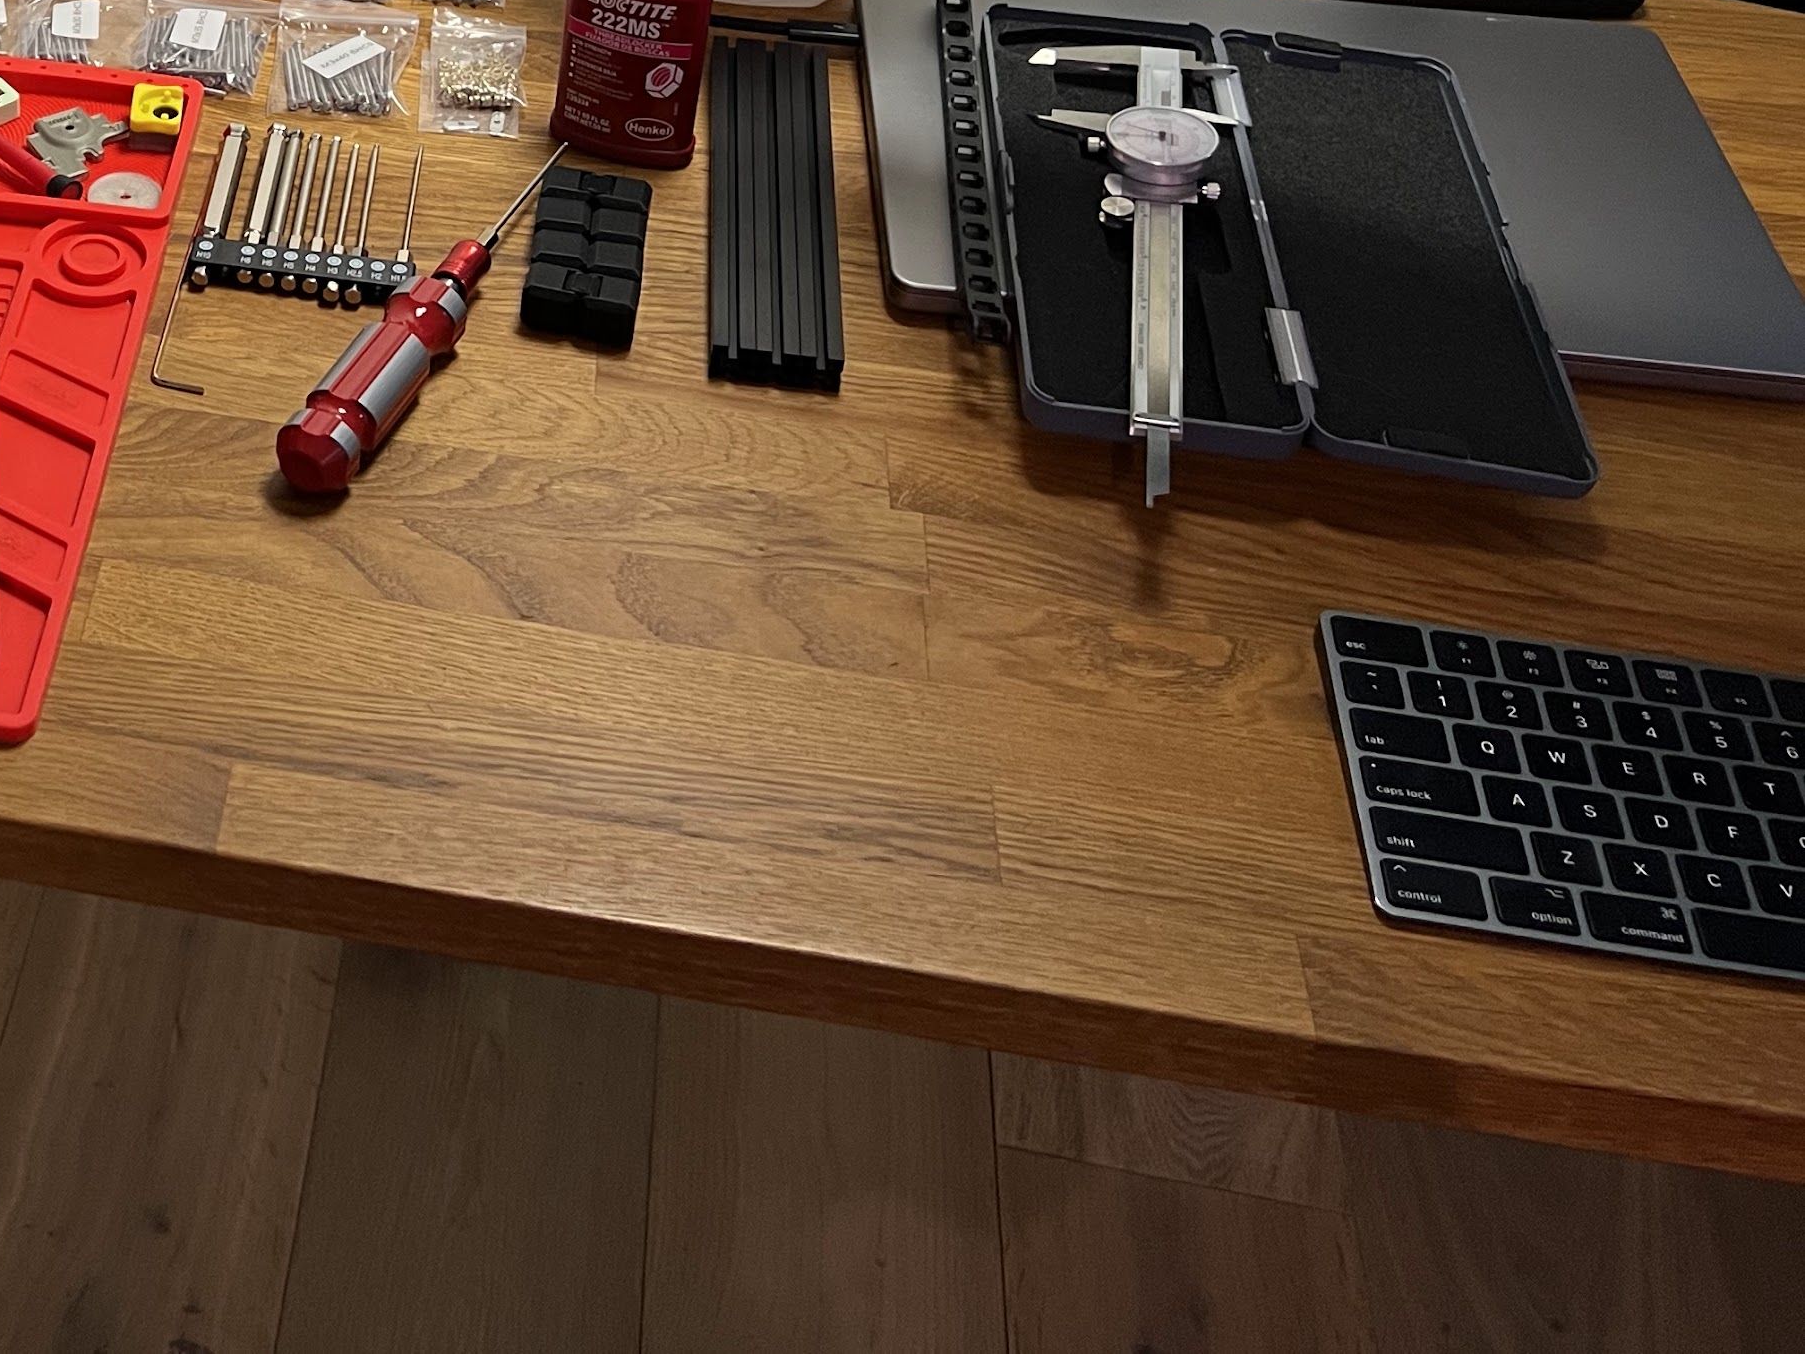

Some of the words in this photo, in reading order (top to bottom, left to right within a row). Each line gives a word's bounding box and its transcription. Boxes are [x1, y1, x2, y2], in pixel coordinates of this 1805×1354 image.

[591, 8, 661, 39] 222MS
[628, 123, 670, 136] Henkel
[196, 250, 212, 259] H10
[305, 263, 316, 272] H4
[327, 266, 338, 275] H3
[346, 268, 362, 278] H2.5
[370, 271, 383, 280] H2
[1345, 641, 1366, 650] esc
[1438, 696, 1446, 707] 1
[1506, 705, 1518, 718] 2
[1575, 716, 1588, 728] 3
[1364, 734, 1385, 745] tab
[1645, 727, 1658, 739] 4
[1480, 740, 1495, 754] Q
[1714, 736, 1728, 748] 5
[1547, 750, 1566, 764] W
[1786, 746, 1799, 759] 6
[1622, 762, 1635, 776] E
[1693, 772, 1707, 786] R
[1376, 785, 1404, 797] caps
[1406, 789, 1432, 801] lock
[1763, 782, 1775, 795] T
[1512, 794, 1526, 807] A
[1583, 804, 1597, 818] S
[1654, 814, 1669, 828] D
[1727, 825, 1739, 838] F
[1386, 835, 1416, 848] shift
[1560, 850, 1575, 865] Z
[1633, 861, 1649, 876] X
[1707, 874, 1722, 887] C
[1397, 889, 1442, 904] control
[1779, 883, 1793, 898] V
[1531, 911, 1573, 926] option
[1621, 926, 1685, 943] command
